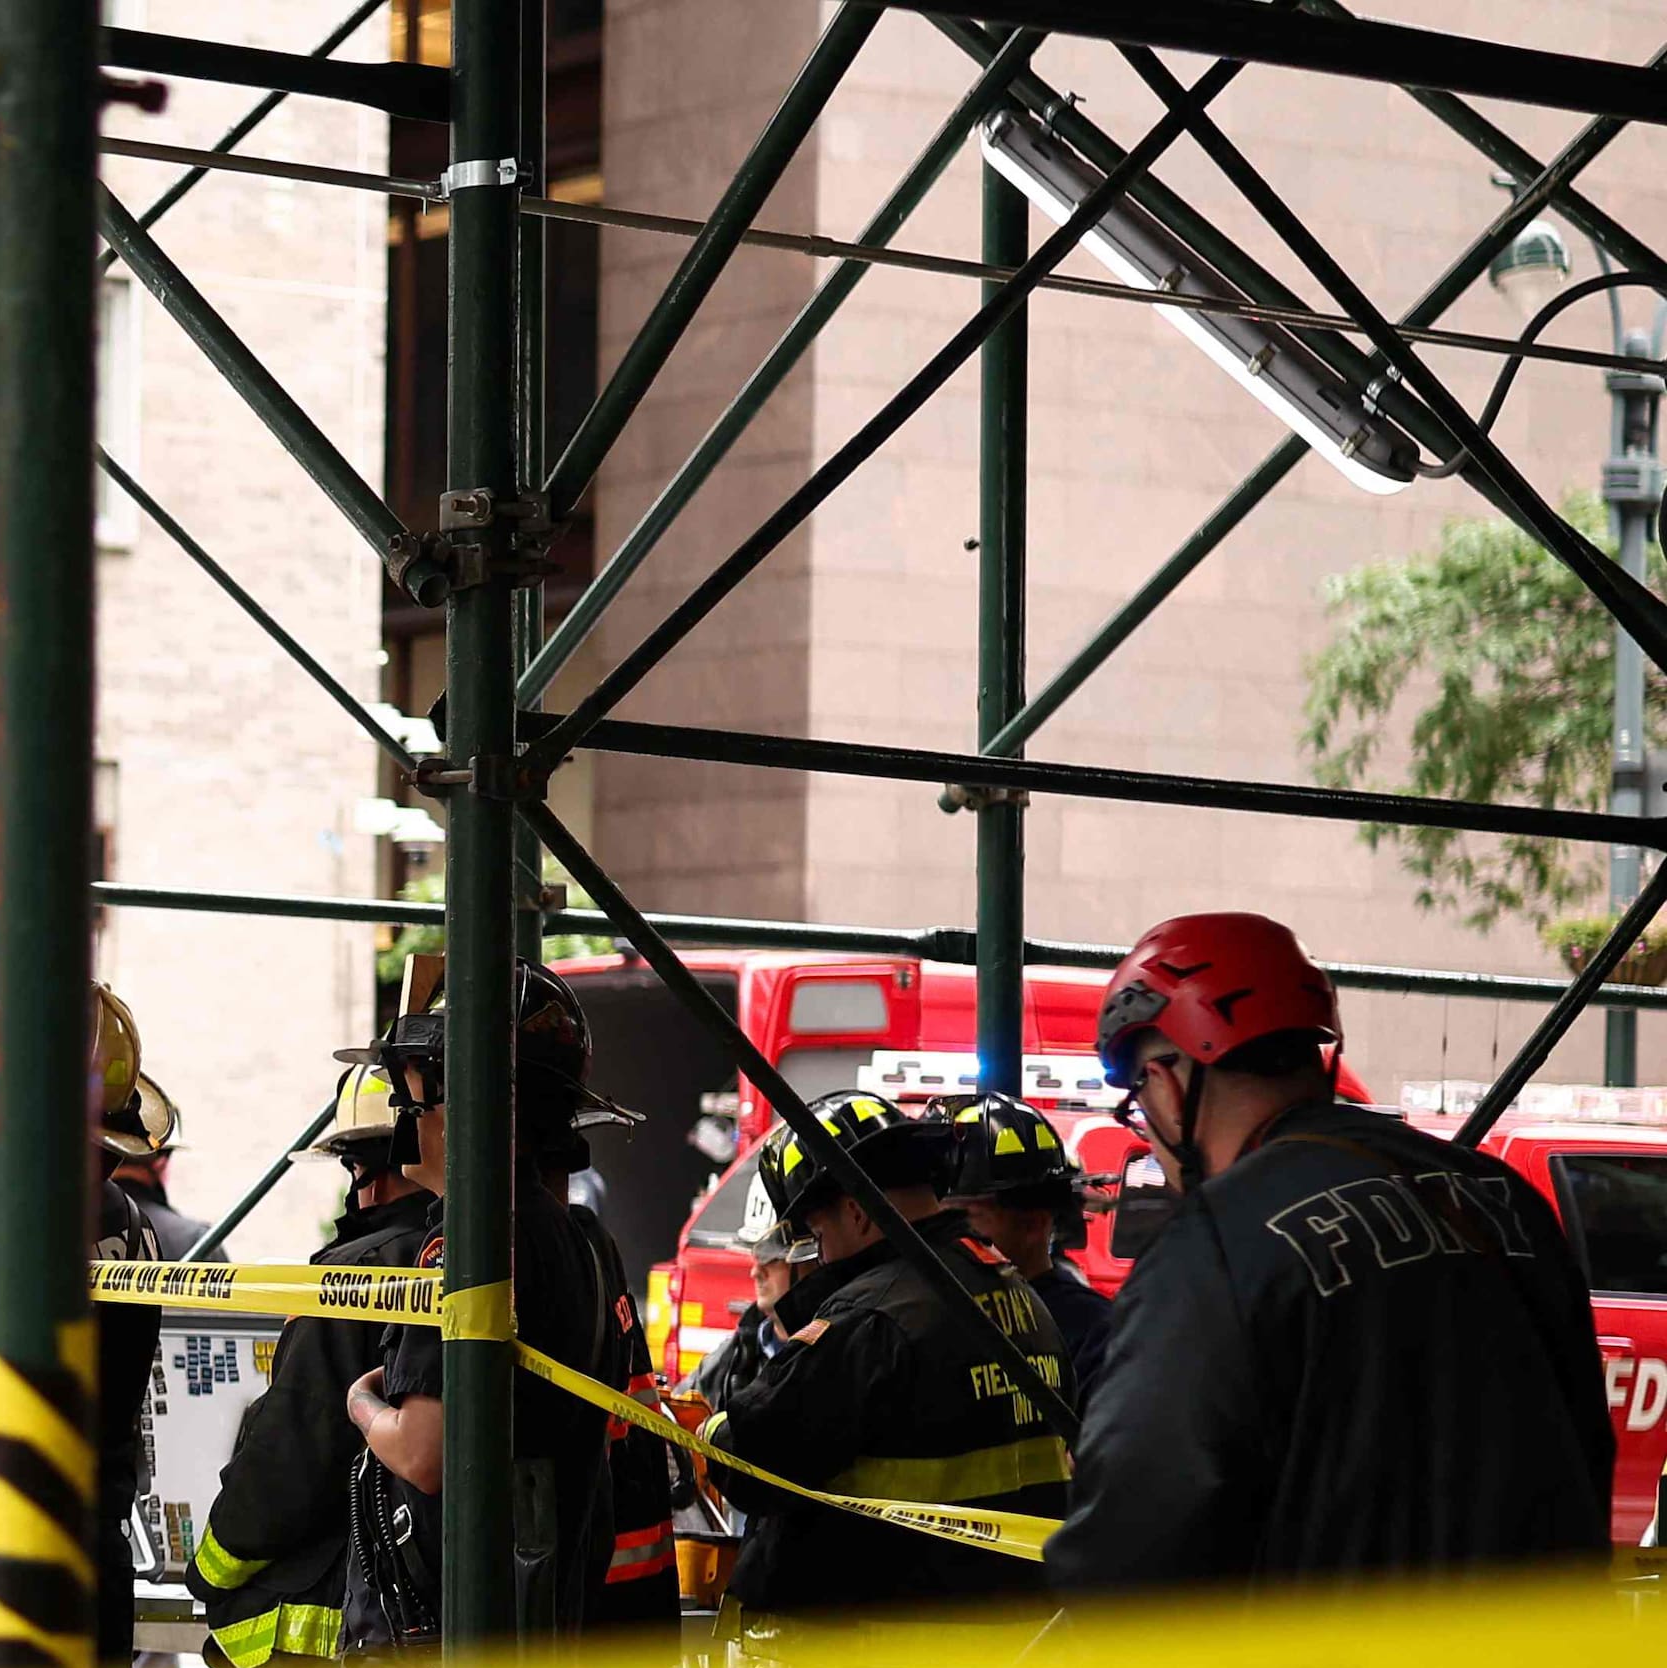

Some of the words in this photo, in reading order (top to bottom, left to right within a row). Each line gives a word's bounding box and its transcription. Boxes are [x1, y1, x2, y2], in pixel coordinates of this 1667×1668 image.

[1265, 1171, 1537, 1297] FDNY
[101, 1266, 132, 1291] NOT
[135, 1268, 156, 1293] DO
[162, 1266, 196, 1297] LINE
[196, 1267, 238, 1299] FIRE
[318, 1271, 373, 1310] CROSS
[373, 1274, 408, 1312] NOT
[410, 1276, 433, 1315] DO
[970, 1361, 1019, 1401] FIEL
[1605, 1356, 1667, 1432] FD
[1012, 1392, 1043, 1425] UNI
